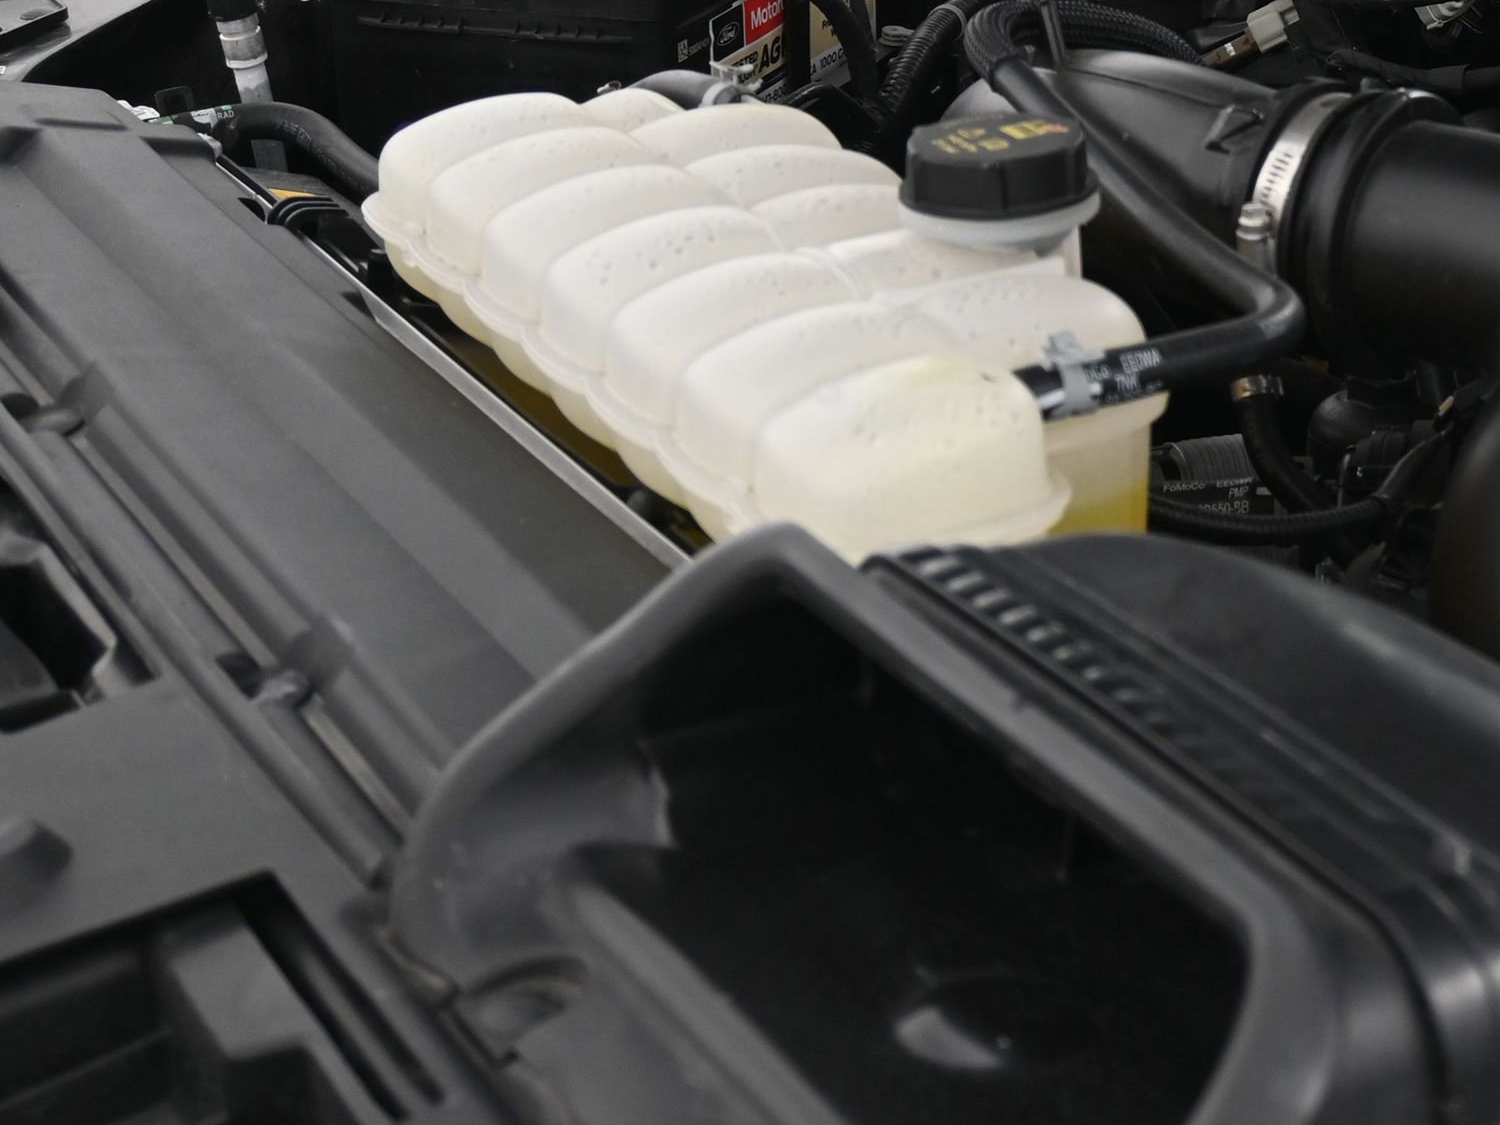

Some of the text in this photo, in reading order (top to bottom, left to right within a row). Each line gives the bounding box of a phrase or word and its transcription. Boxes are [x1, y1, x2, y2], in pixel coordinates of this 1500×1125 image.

[731, 51, 758, 68] STED
[759, 35, 784, 74] AG
[216, 110, 235, 121] RAD
[1162, 483, 1206, 493] FoMoCo
